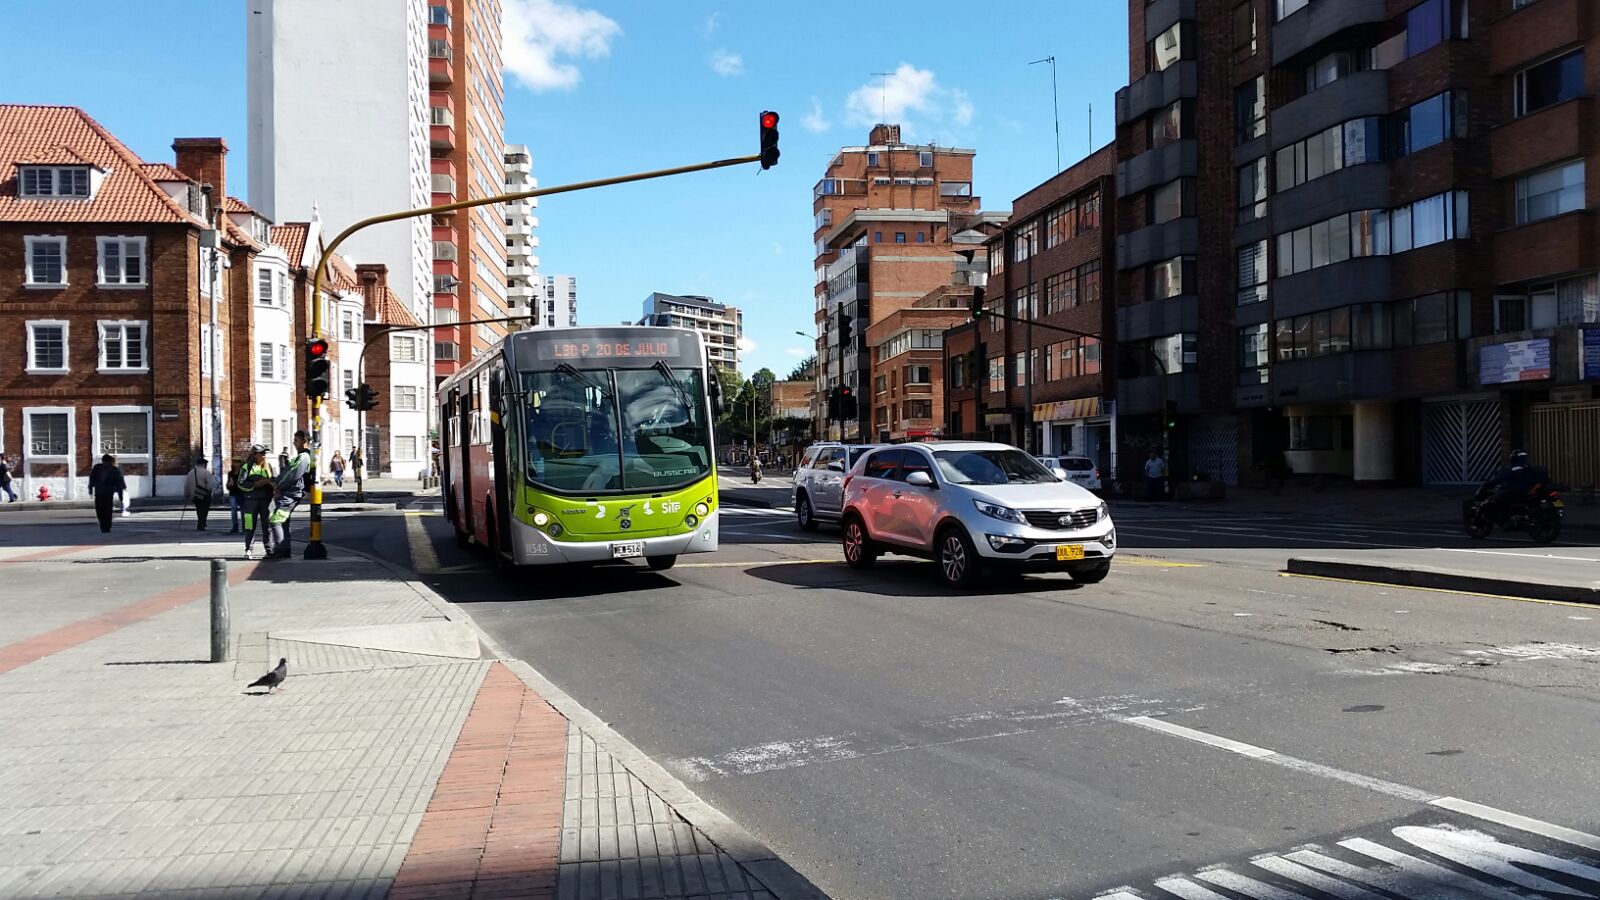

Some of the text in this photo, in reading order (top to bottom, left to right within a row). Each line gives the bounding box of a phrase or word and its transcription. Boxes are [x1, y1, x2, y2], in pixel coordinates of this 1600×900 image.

[596, 343, 612, 356] 20
[615, 343, 631, 356] DE
[634, 343, 667, 356] JULIO
